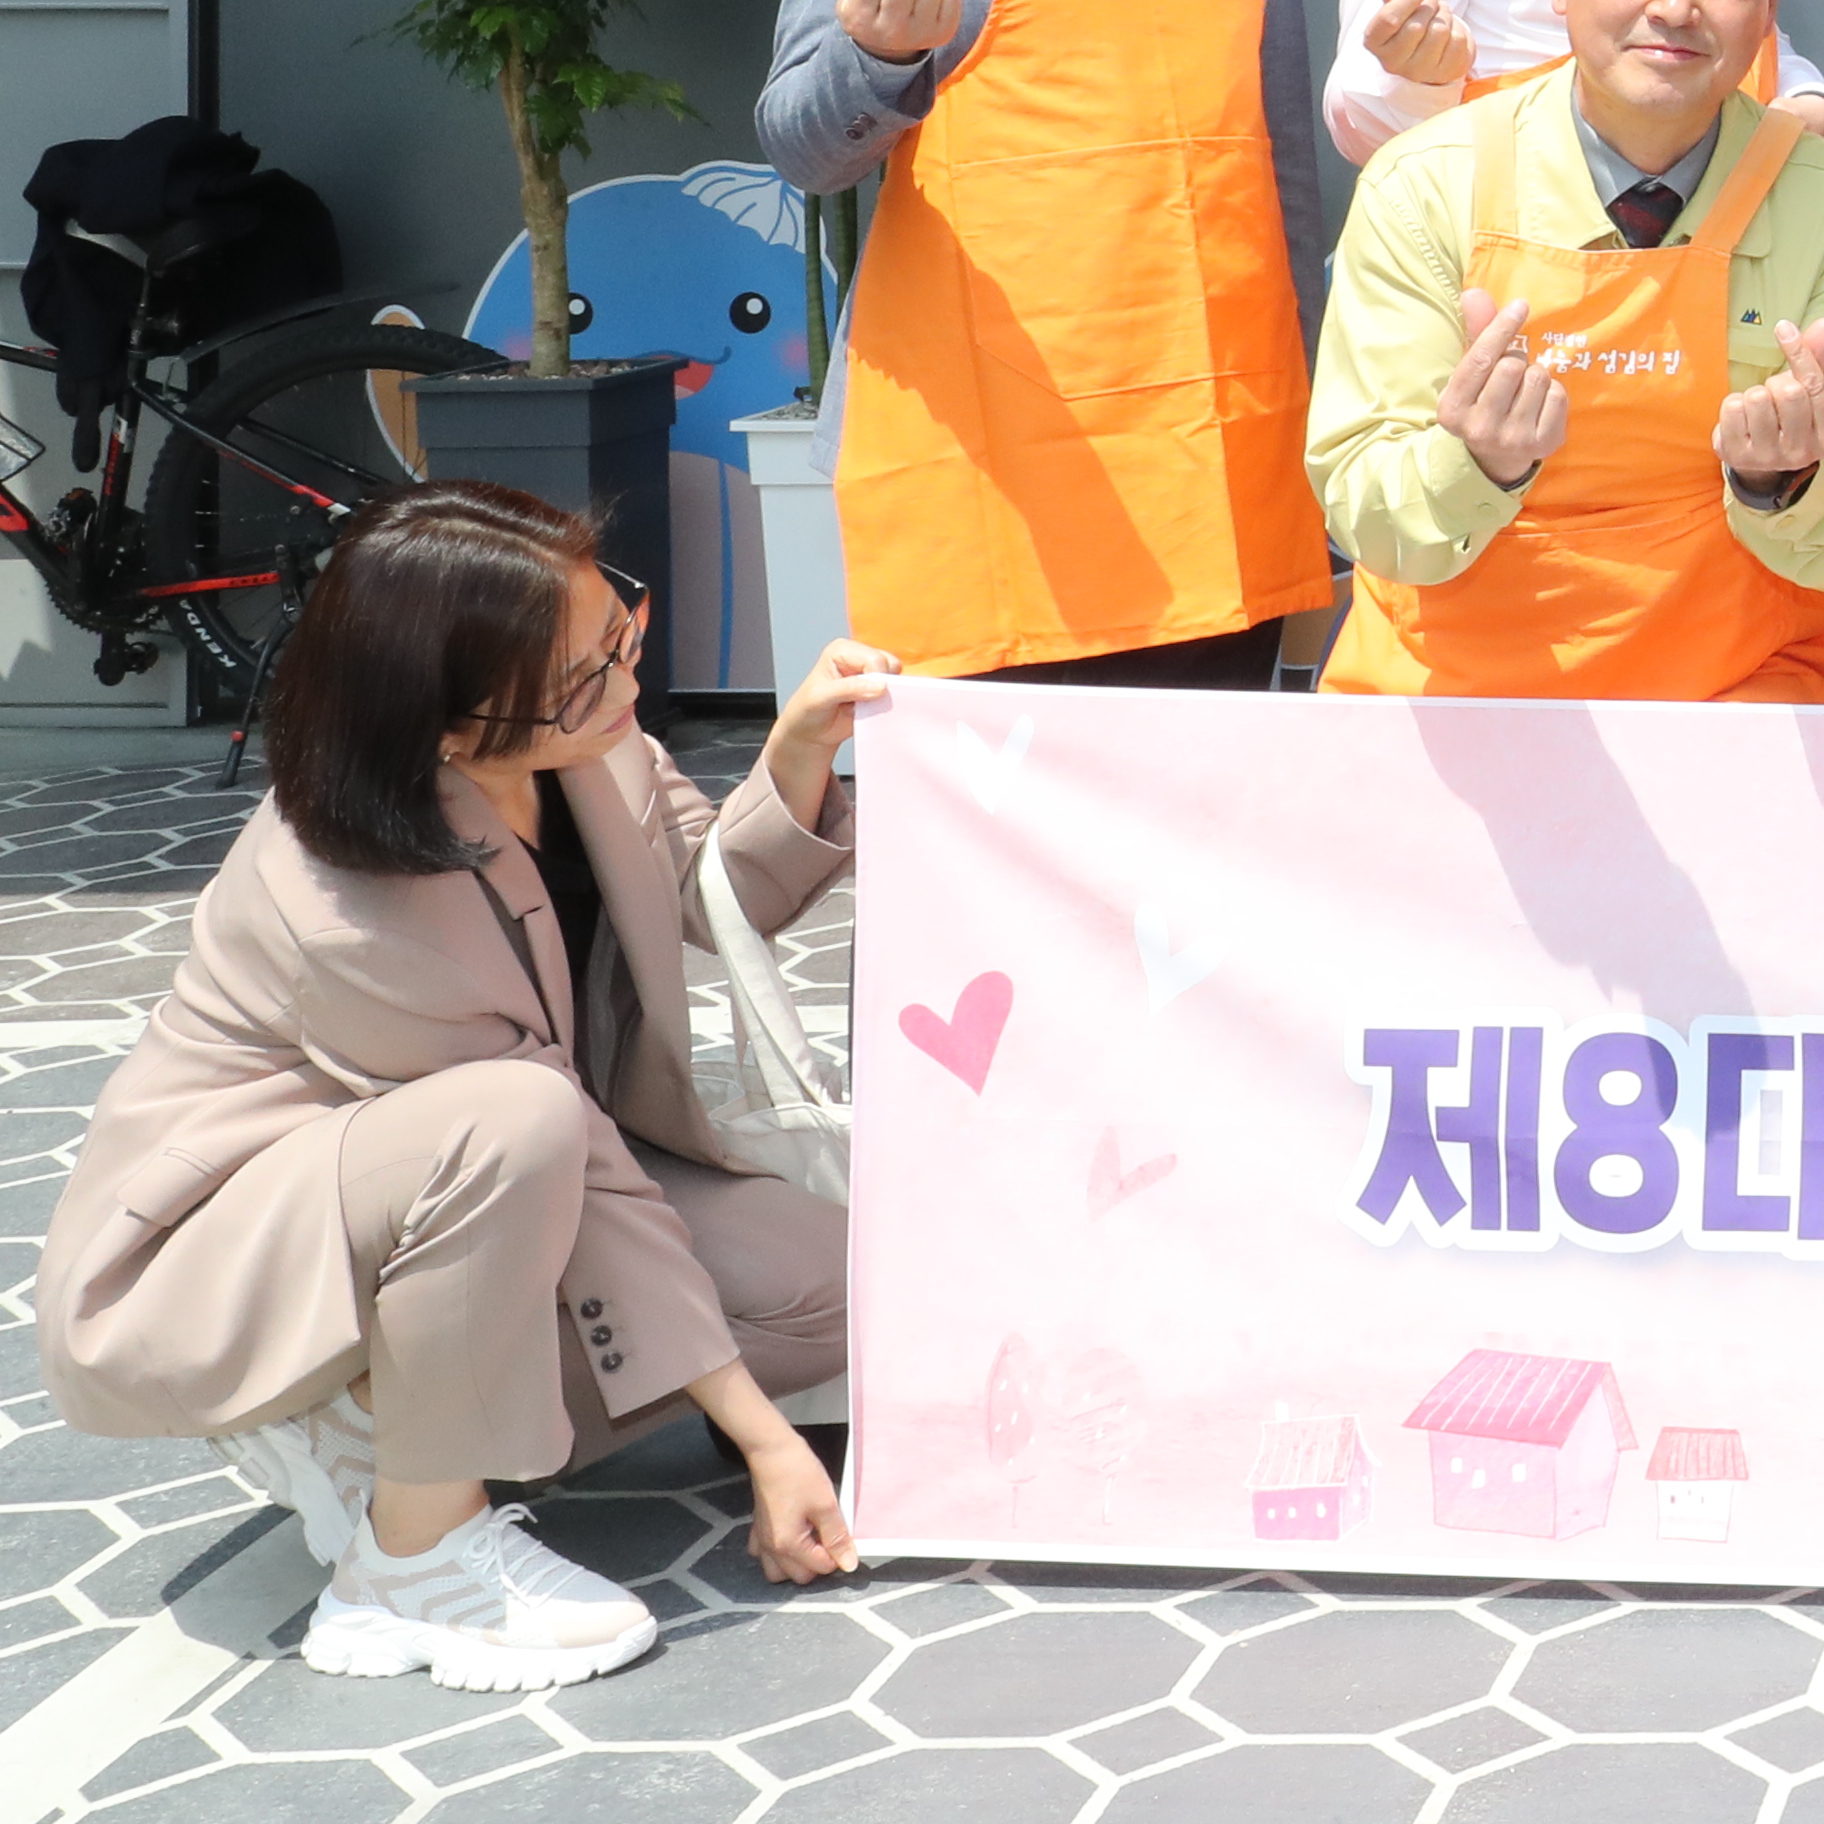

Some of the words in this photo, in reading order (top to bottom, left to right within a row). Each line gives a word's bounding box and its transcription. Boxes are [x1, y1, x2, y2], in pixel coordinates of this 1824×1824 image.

[1597, 350, 1656, 375] 섬김의
[1662, 350, 1681, 375] 집
[179, 599, 237, 668] KENDA
